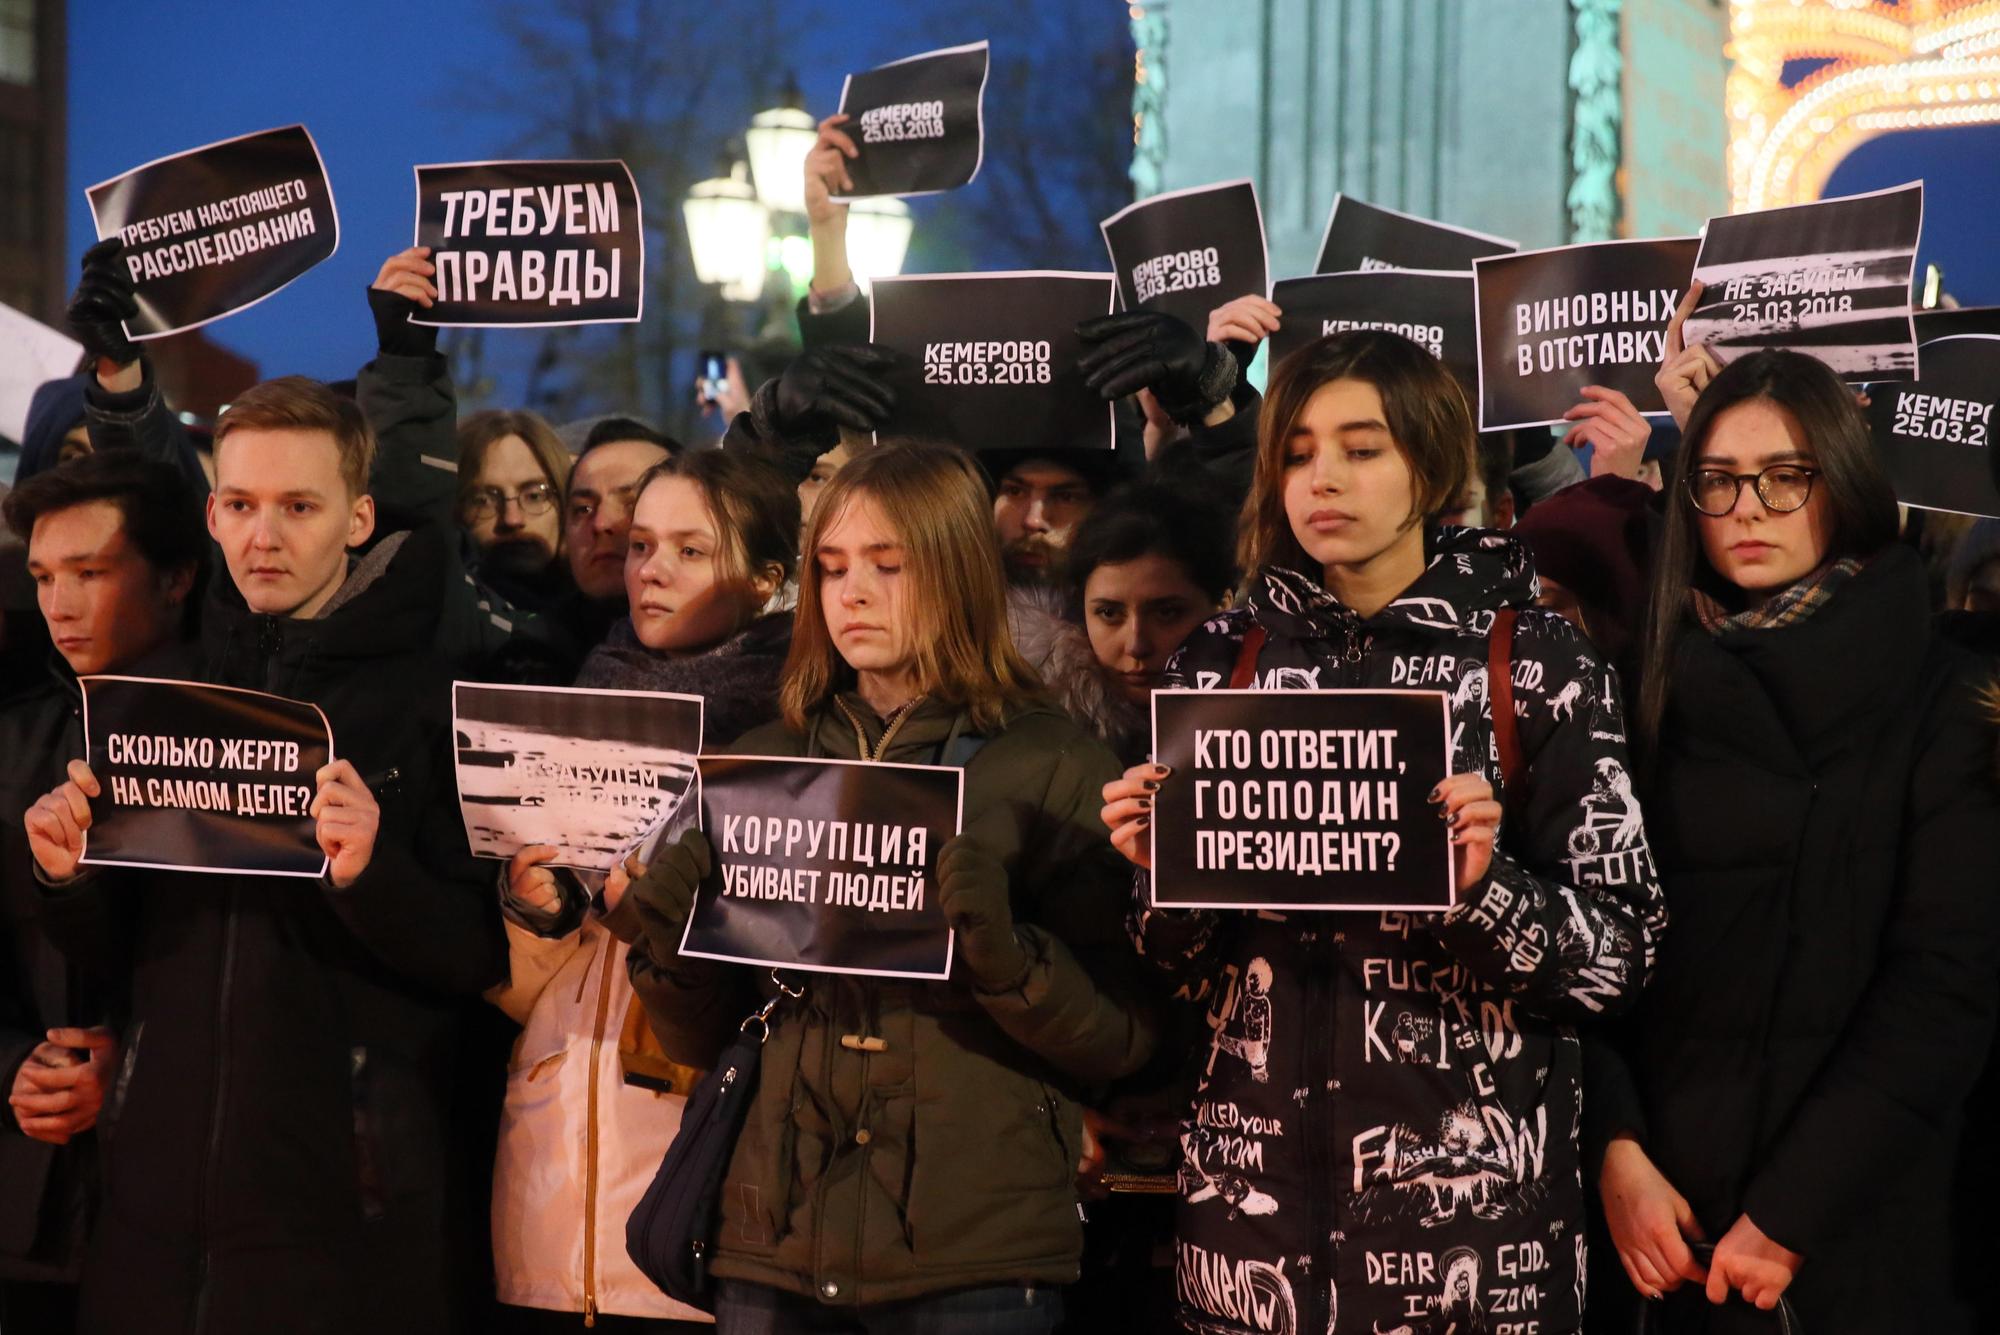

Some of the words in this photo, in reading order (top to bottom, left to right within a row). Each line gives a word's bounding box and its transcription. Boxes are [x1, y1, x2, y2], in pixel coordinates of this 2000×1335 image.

[860, 100, 944, 125] КЕМЕРОВО
[861, 120, 945, 143] 25.03.2018
[119, 209, 197, 248] ТРЕБУЕМ
[197, 178, 308, 228] НАСТОЯЩЕГО
[440, 181, 620, 238] ТРЕБУЕМ
[126, 207, 316, 284] РАССЛЕДОВАНИЯ
[435, 247, 621, 306] ПРАВДЫ
[1723, 278, 1753, 301] НЕ
[1757, 266, 1865, 299] ЗАБУДЕМ
[1516, 289, 1678, 336] ВИНОВНЫХ
[1732, 294, 1853, 324] 25.03.2018
[924, 340, 1051, 363] КЕМЕРОВО
[1517, 343, 1534, 377] В
[1539, 330, 1668, 373] ОТСТАВКУ
[924, 362, 1052, 385] 25.03.2018
[1892, 413, 1988, 446] 25.03.2
[1391, 655, 1456, 685] DEAR
[1511, 659, 1546, 693] OD.
[108, 733, 214, 768] СКОЛЬКО
[219, 738, 299, 772] ЖЕРТВ
[1194, 729, 1251, 770] КТО
[1260, 729, 1406, 775] ОТВЕТИТ,
[111, 776, 144, 806] НА
[147, 778, 231, 811] САМОМ
[237, 783, 311, 817] ДЕЛЕ?
[1195, 780, 1399, 825] ГОСПОДИН
[722, 814, 928, 868] КОРРУПЦИЯ
[1196, 830, 1401, 876] ПРЕЗИДЕНТ?
[721, 863, 822, 904] УБИВАЕТ
[825, 870, 925, 913] ЛЮДЕЙ
[1240, 1115, 1283, 1136] YOUR
[1206, 1134, 1264, 1173] MOM
[1365, 1251, 1437, 1286] DEAR
[1497, 1240, 1550, 1280] GOD.
[1404, 1294, 1429, 1318] I
[1488, 1283, 1547, 1313] ZOM-
